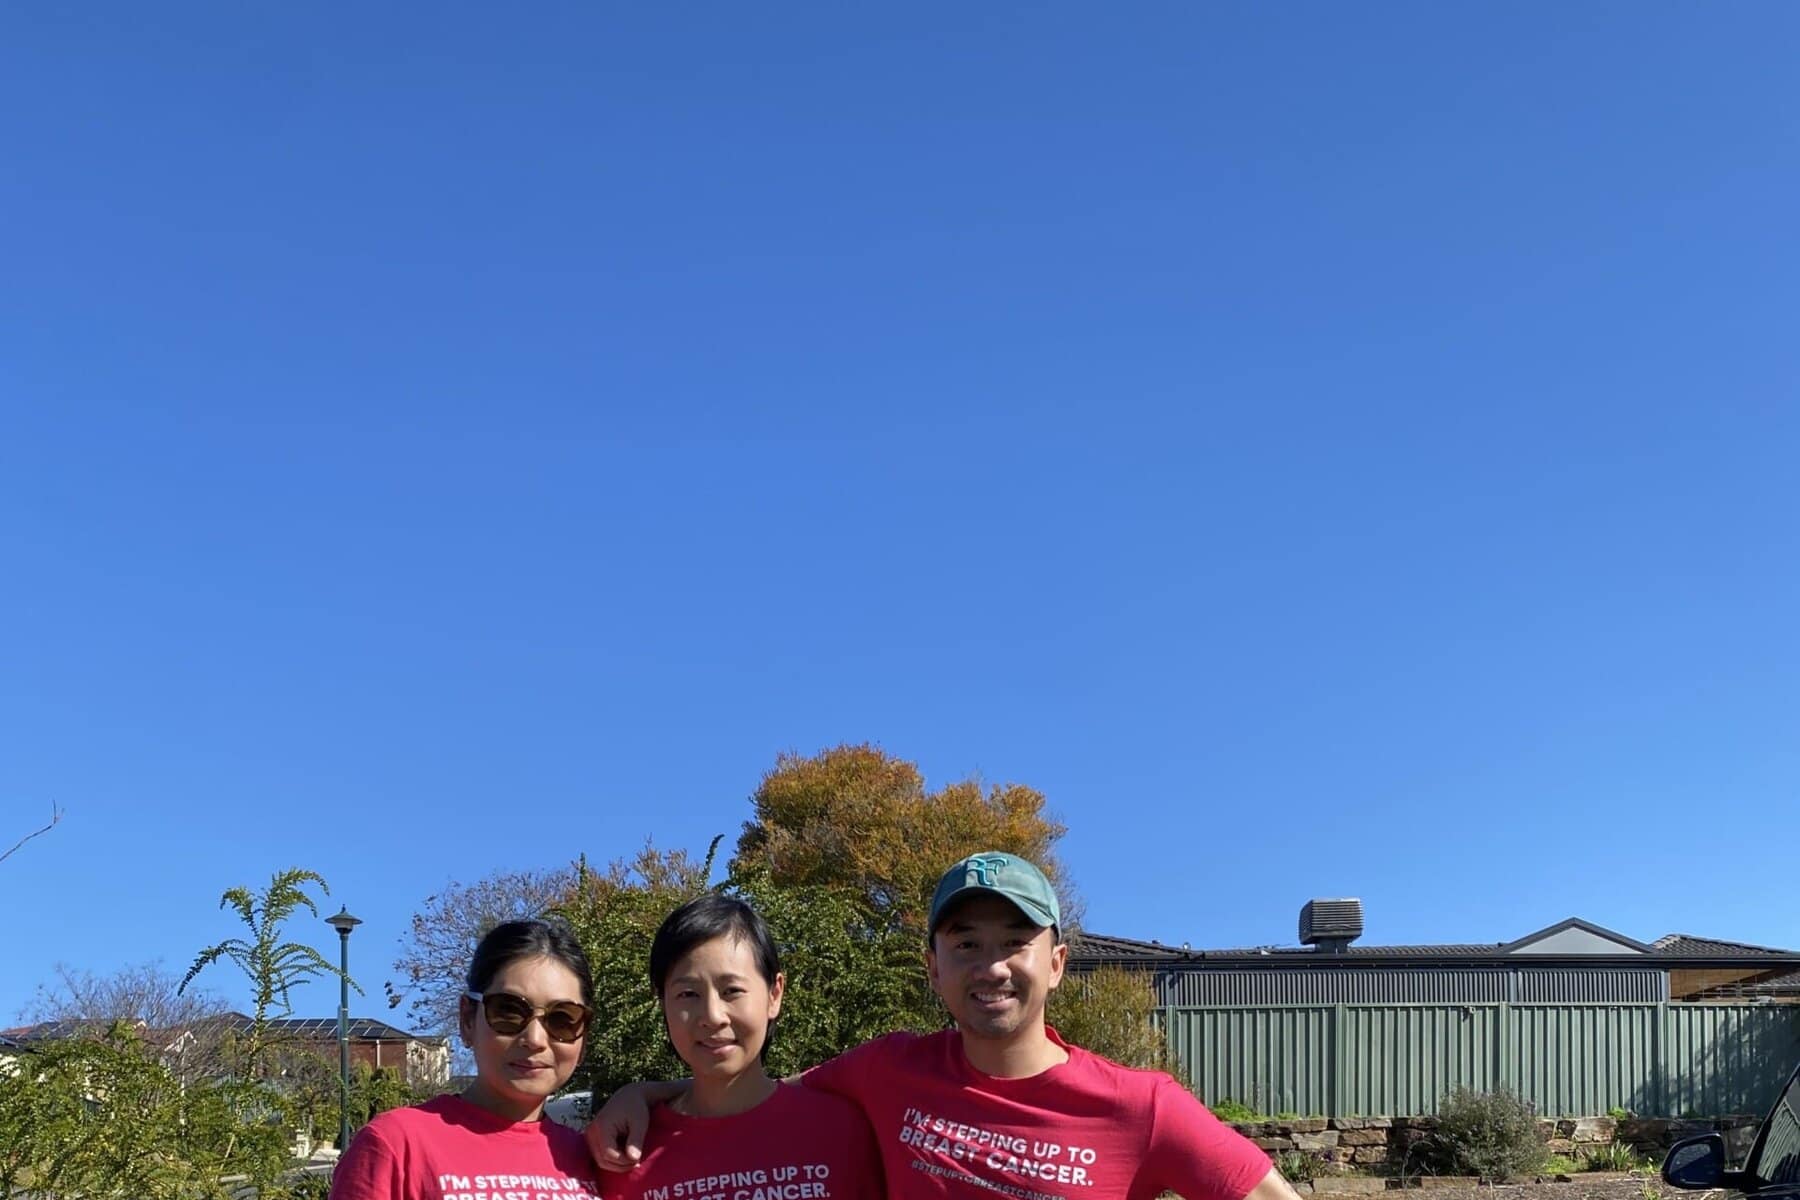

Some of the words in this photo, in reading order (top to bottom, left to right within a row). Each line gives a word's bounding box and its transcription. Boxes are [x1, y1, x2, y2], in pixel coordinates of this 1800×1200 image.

[899, 1126, 980, 1162] BREAST
[985, 1152, 1094, 1186] CANCER.
[903, 1107, 932, 1127] I'M
[932, 1118, 1027, 1154] STEPPING
[1033, 1141, 1061, 1158] UP
[1067, 1146, 1096, 1165] TO
[438, 1174, 471, 1191] I'M
[475, 1175, 560, 1191] STEPPING
[673, 1170, 768, 1197] STEPPING
[772, 1166, 799, 1182] UP
[802, 1164, 830, 1180] TO
